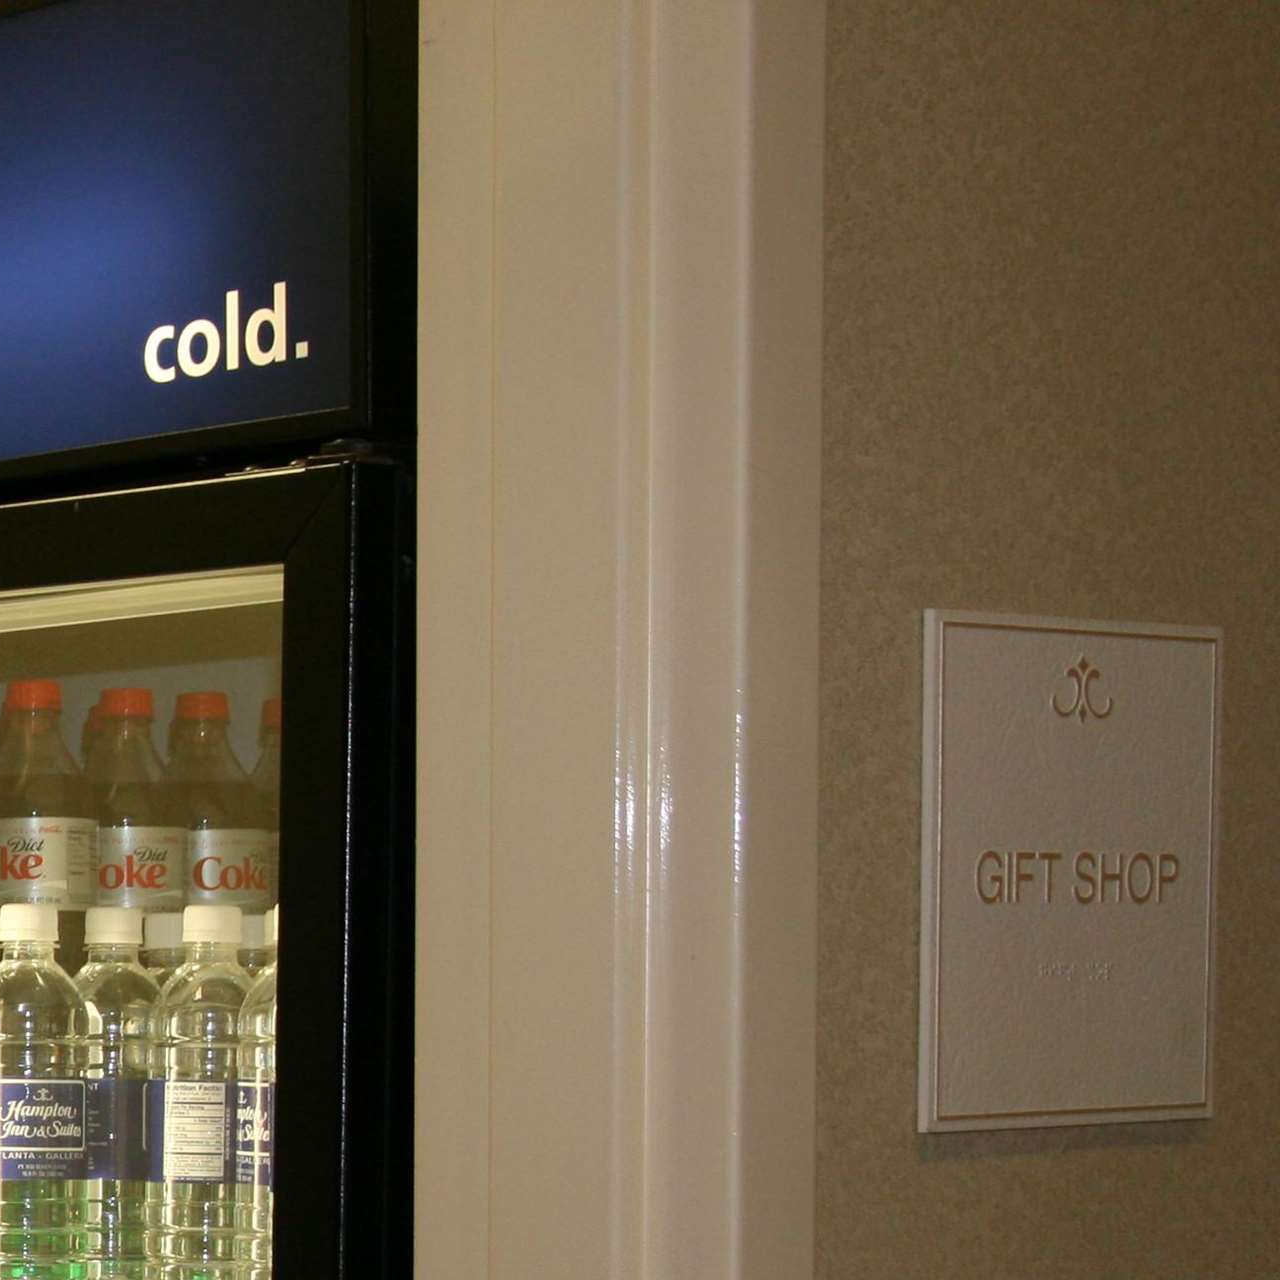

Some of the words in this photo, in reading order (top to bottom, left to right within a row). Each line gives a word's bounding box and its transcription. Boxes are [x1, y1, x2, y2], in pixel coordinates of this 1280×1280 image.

[143, 281, 309, 384] cold.
[7, 837, 45, 852] Diet
[134, 847, 169, 862] Diet
[975, 850, 1062, 904] GIFT
[1072, 851, 1180, 905] SHOP
[37, 1126, 48, 1138] &
[46, 1120, 82, 1138] Suites
